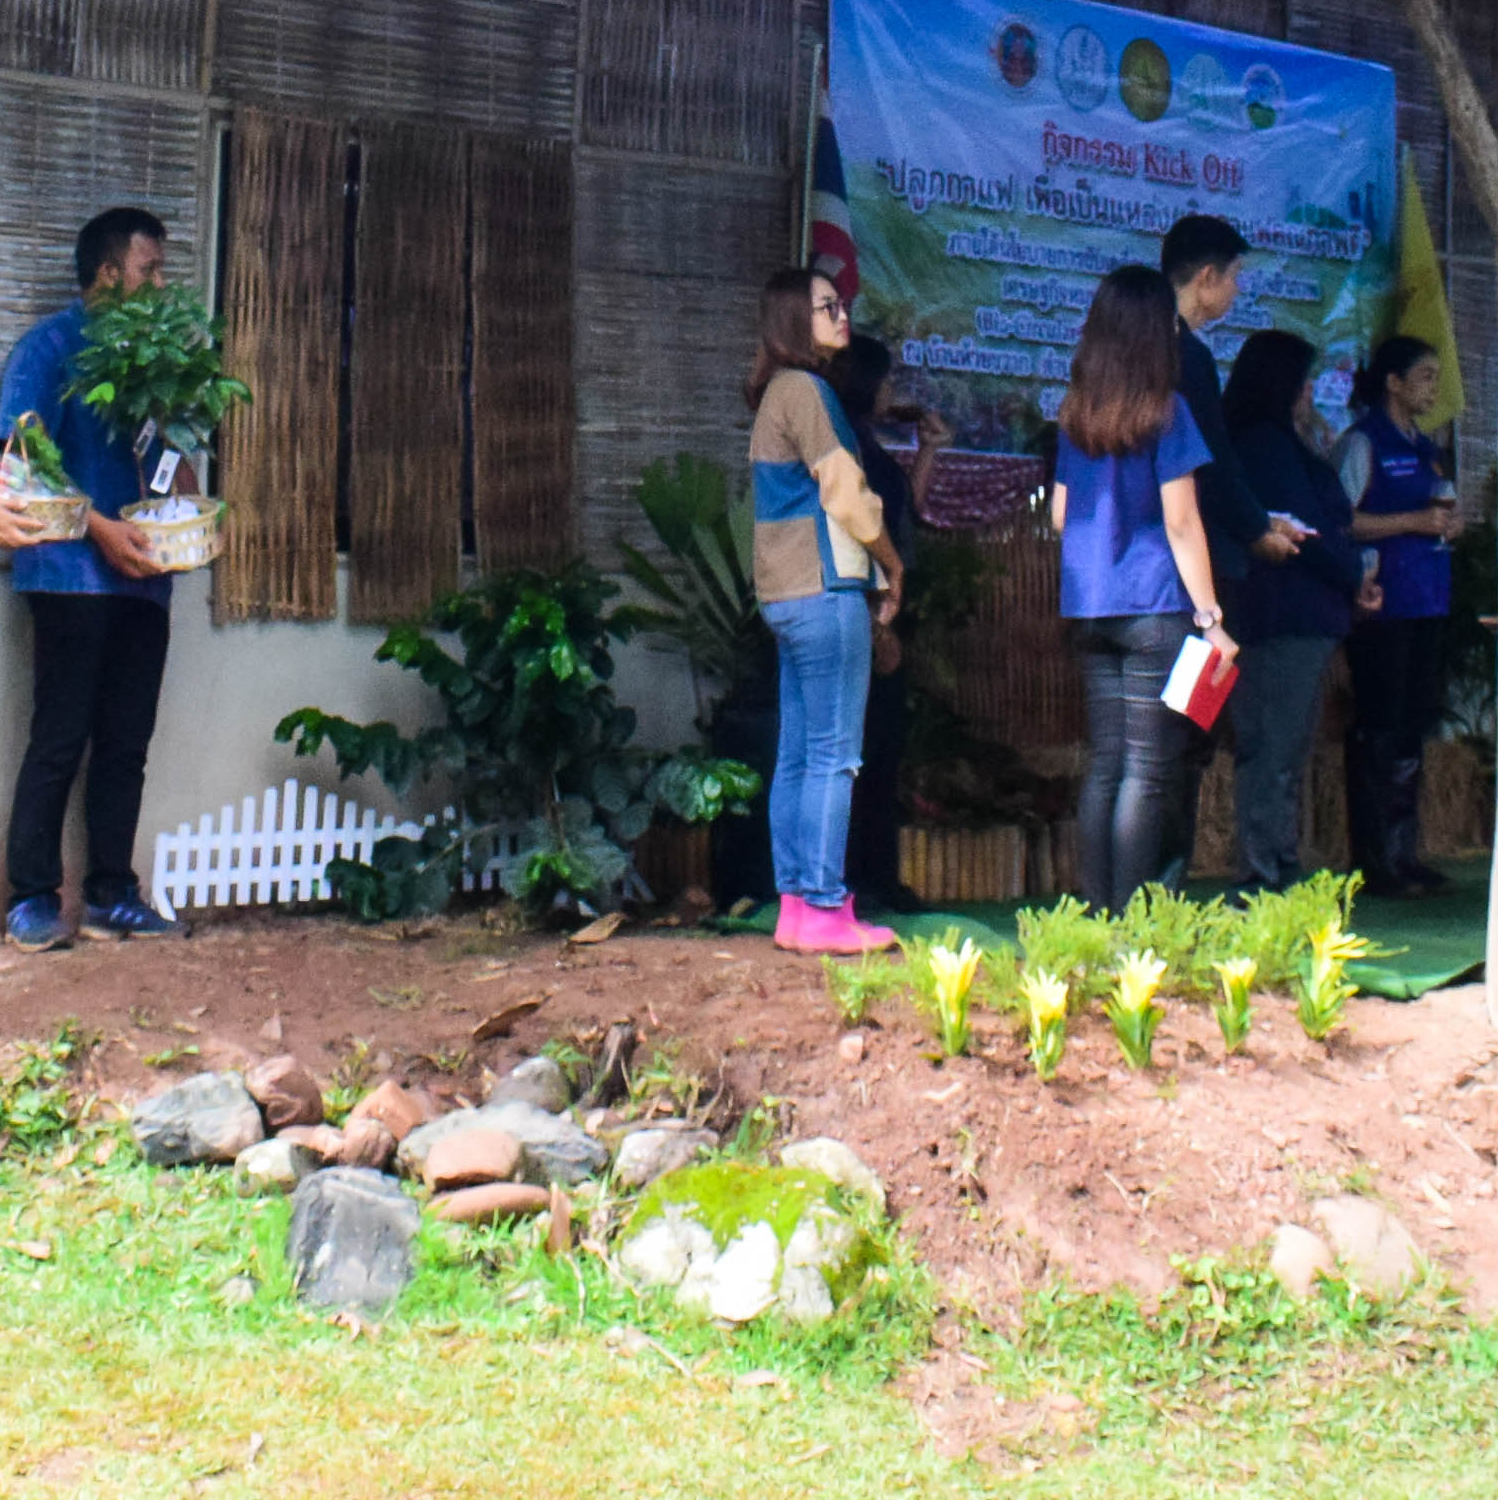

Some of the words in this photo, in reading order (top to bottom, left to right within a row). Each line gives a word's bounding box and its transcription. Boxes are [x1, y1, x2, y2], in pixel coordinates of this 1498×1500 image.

[1042, 119, 1138, 174] กิจกรรม
[1143, 141, 1195, 183] Kick
[1203, 153, 1243, 190] Off
